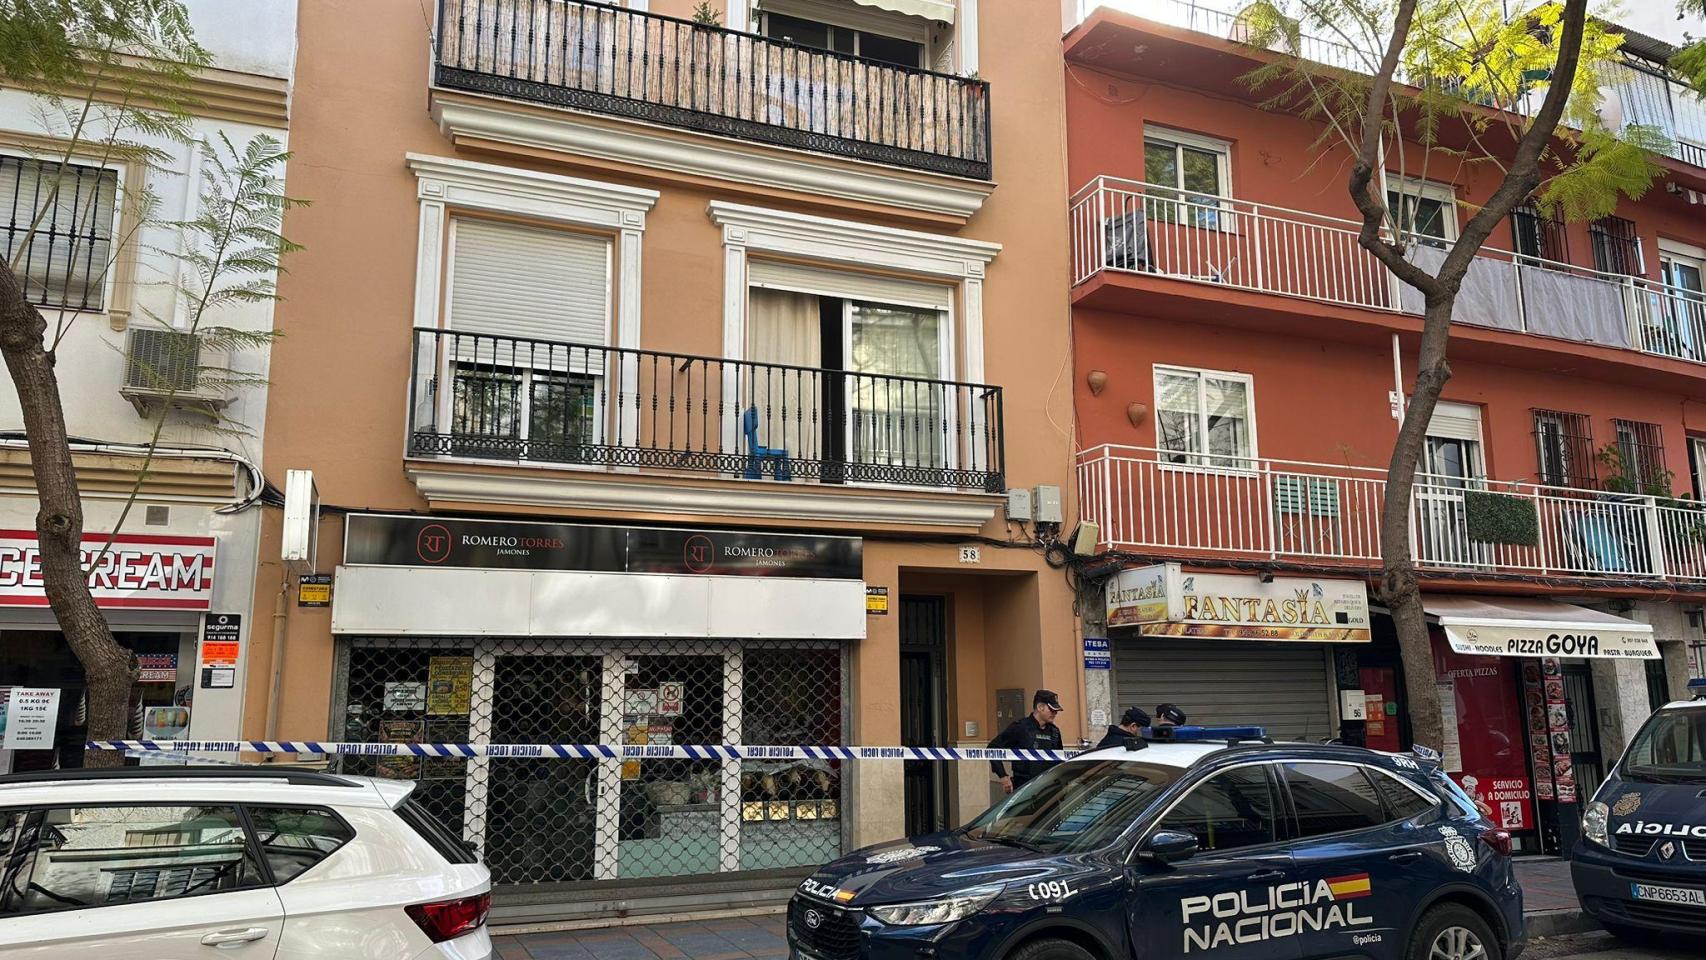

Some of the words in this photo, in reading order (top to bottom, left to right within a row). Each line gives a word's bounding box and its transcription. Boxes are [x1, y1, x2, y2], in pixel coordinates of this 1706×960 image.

[462, 535, 517, 547] ROMERO
[518, 537, 565, 549] TORRES
[496, 548, 530, 556] JAMONES
[724, 546, 774, 558] ROMERO
[963, 550, 976, 559] 58
[755, 559, 786, 567] JAMONES
[1475, 645, 1503, 653] NOODLES
[1507, 639, 1544, 654] PIZZA
[1546, 633, 1599, 655] GOYA
[1473, 667, 1498, 676] PIZZAS
[205, 742, 241, 752] POLICIA
[335, 743, 362, 755] LOCAL
[365, 744, 398, 755] POLICIA
[485, 745, 509, 756] LOCAL
[512, 745, 543, 756] POLICIA
[622, 746, 646, 757] LOCAL
[646, 746, 675, 757] POLICIA
[747, 746, 767, 757] LOCAL
[768, 747, 794, 757] POLICIA
[860, 747, 879, 757] LOCAL
[881, 748, 904, 758] POLICIA
[1391, 756, 1420, 769] 9RH
[1493, 780, 1523, 790] SERVICIO
[1487, 791, 1494, 801] A
[1494, 790, 1530, 800] DOMICILIO
[1029, 880, 1079, 900] C091
[1637, 886, 1705, 905] CNP6653AL
[1183, 902, 1373, 953] NACIONAL
